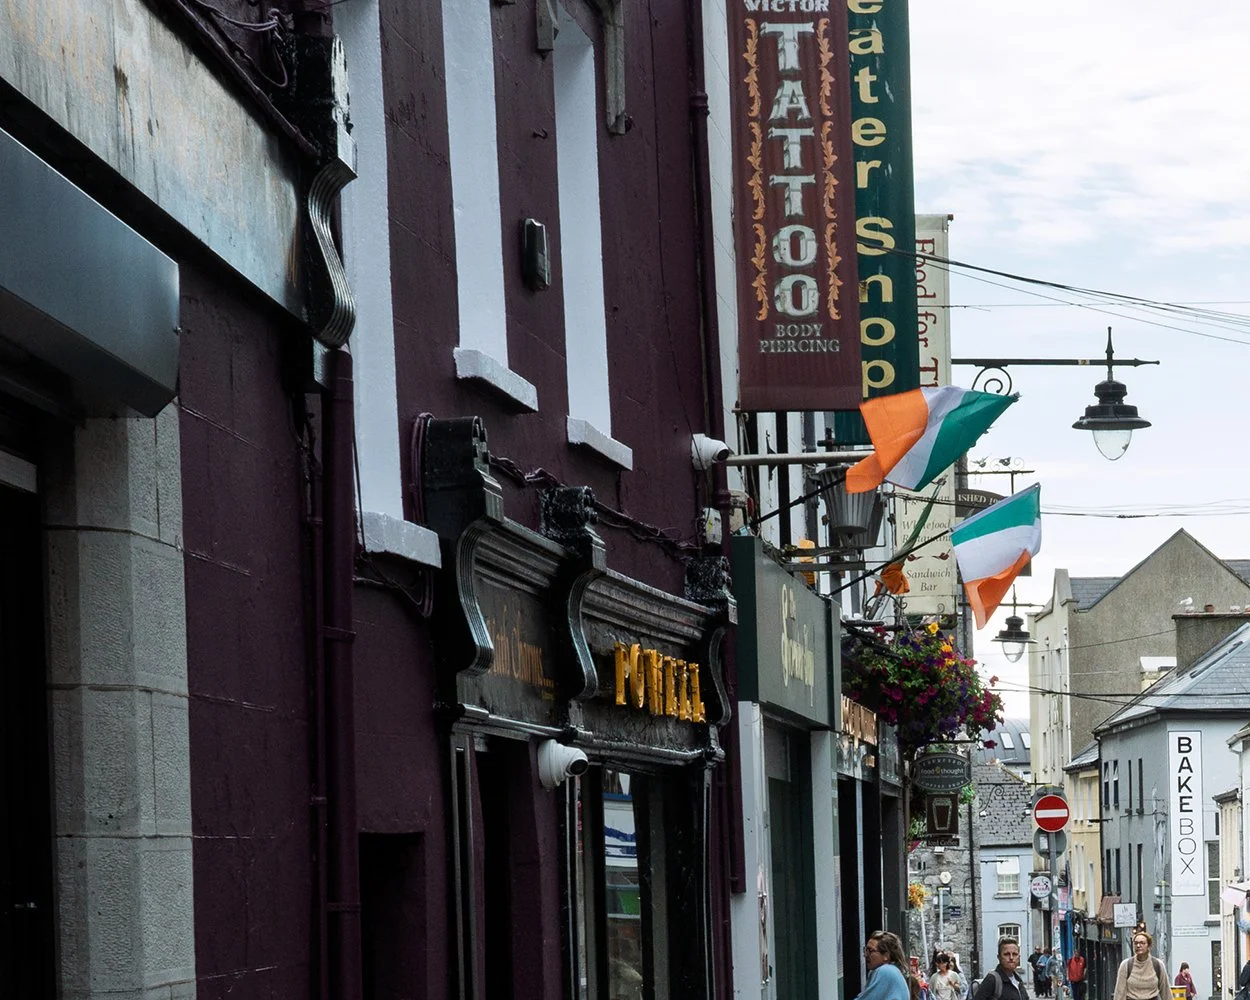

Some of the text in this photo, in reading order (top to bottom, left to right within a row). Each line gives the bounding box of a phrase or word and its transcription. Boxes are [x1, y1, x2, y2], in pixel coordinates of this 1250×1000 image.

[743, 0, 829, 12] VICTOR
[759, 21, 821, 318] TATTOO
[775, 323, 823, 338] BODY
[759, 339, 841, 354] PIERCING
[902, 519, 950, 531] Wefood
[907, 568, 951, 579] Sandwich
[921, 582, 938, 592] Bar
